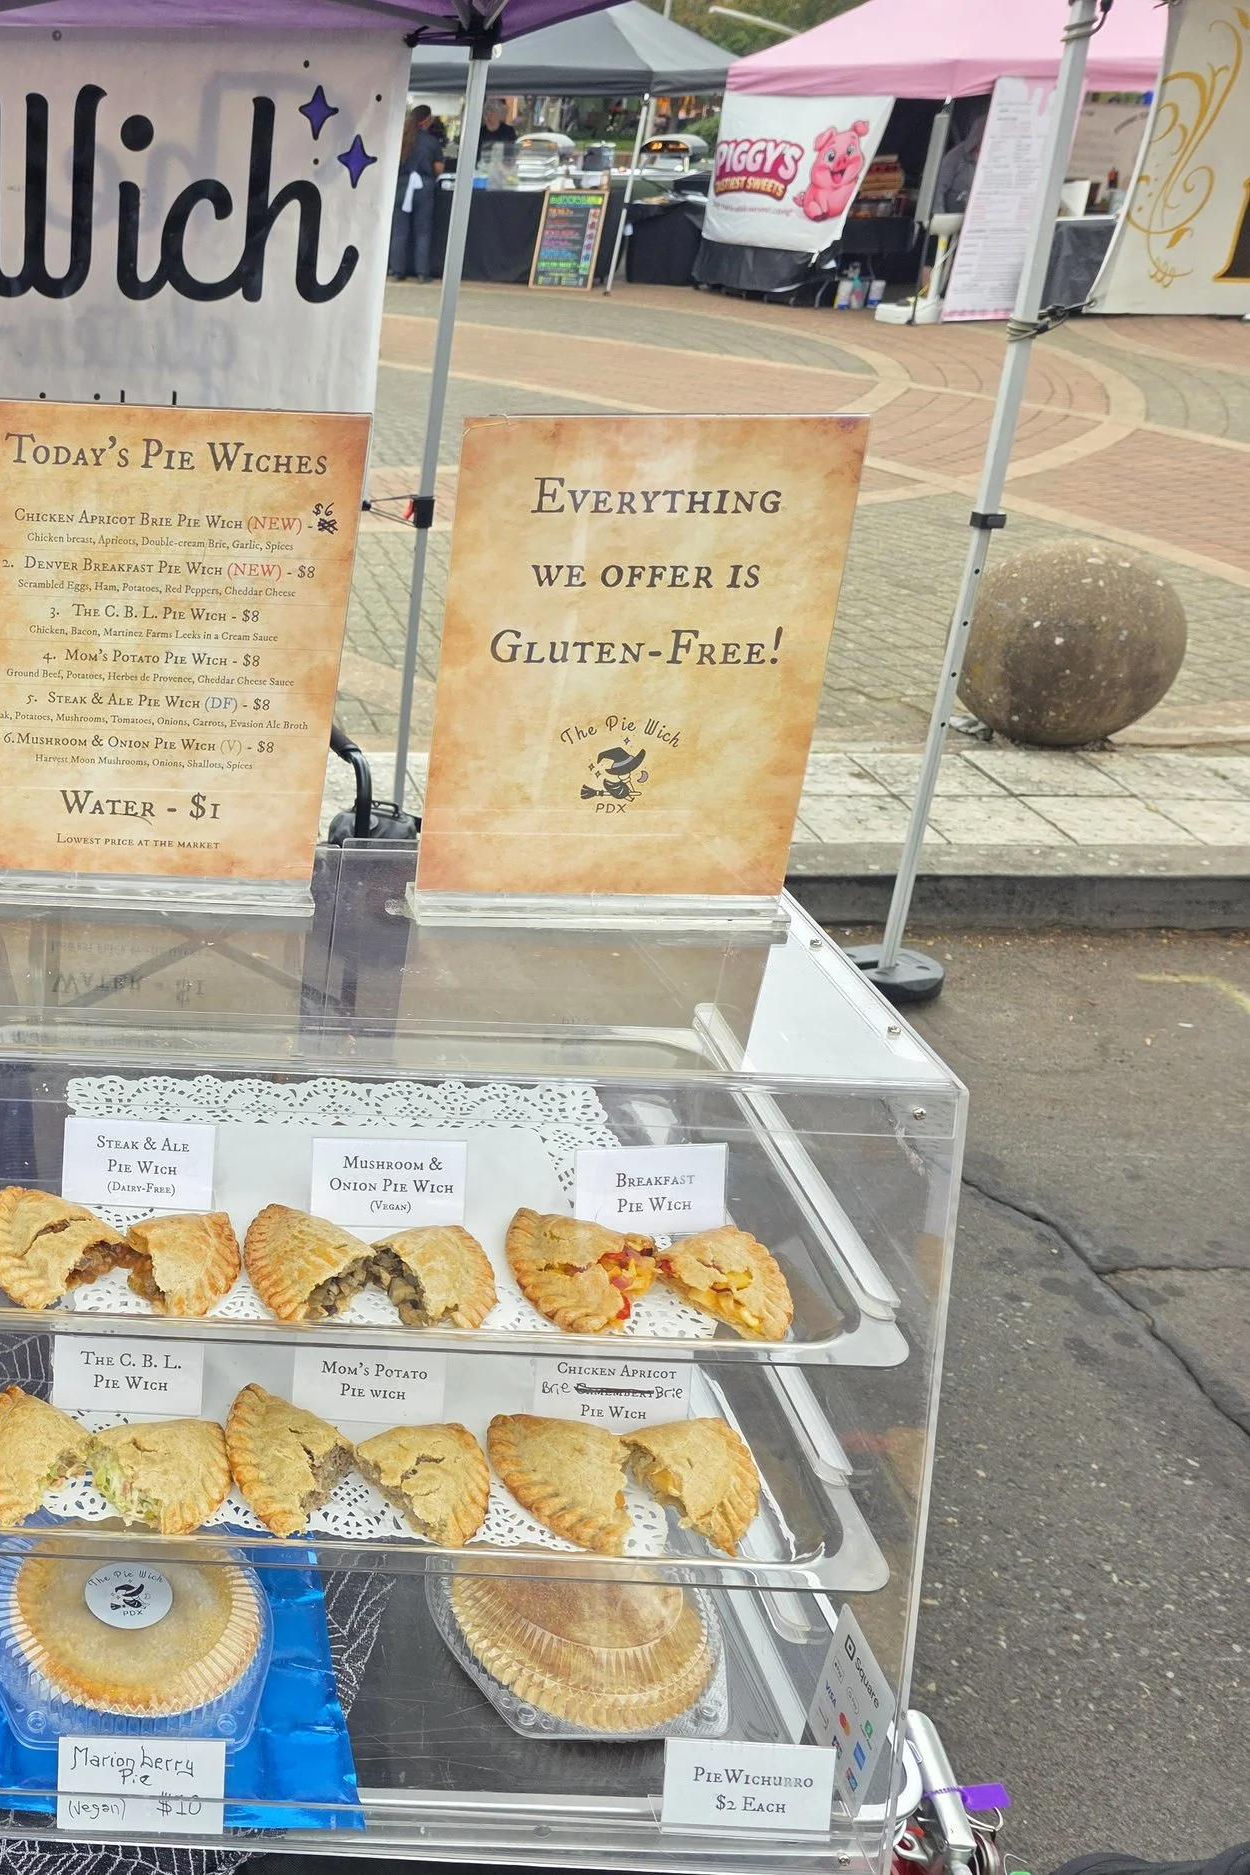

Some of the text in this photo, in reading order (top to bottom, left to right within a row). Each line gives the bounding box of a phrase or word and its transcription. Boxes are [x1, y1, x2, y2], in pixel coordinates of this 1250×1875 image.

[746, 176, 785, 197] SWEETS
[5, 432, 328, 476] TODAY'S PIE WICHES
[530, 476, 784, 515] EVERYTHING
[312, 502, 334, 517] $6
[14, 508, 75, 523] CHICKEN
[78, 510, 136, 525] APRICOT
[139, 512, 173, 527] BRIE
[176, 513, 201, 528] PIE
[205, 515, 243, 529] WICH
[247, 515, 303, 535] (NEW)
[27, 532, 294, 553] Chicken breast, Apricots, Double-cream Brie, Garlic, Spices
[24, 555, 78, 571] DENVER
[81, 557, 154, 573] BREAKFAST
[158, 560, 181, 574] PIE
[185, 561, 223, 575] WICH
[226, 562, 283, 582] (NEW)
[297, 564, 315, 579] $8
[531, 564, 760, 589] WE OFFER IS
[18, 579, 296, 597] Scrambled Eggs, Ham, Potatoes, Red Peppers, Cheddar Cheese
[72, 603, 100, 617] THE
[162, 606, 186, 620] PIE
[190, 608, 226, 621] WICH
[242, 609, 260, 623] $8
[490, 626, 784, 666] GLUTEN-FREE!
[64, 648, 108, 662] MOM'S
[112, 649, 160, 664] POTATO
[164, 651, 187, 664] PIE
[192, 653, 227, 666] WICH
[242, 653, 260, 667] $8
[48, 691, 87, 704] STEAK
[91, 692, 104, 705] &
[107, 693, 134, 706] ALE
[138, 694, 160, 707] PIE
[165, 695, 200, 709] WICH
[204, 696, 238, 714] (DF)
[253, 698, 270, 711] $8
[560, 715, 681, 748] The Pie Wich
[91, 734, 104, 747] &
[108, 736, 150, 749] ONION
[154, 737, 176, 750] PIE
[181, 738, 216, 751] WICH
[257, 740, 274, 753] $8
[35, 753, 253, 772] Harvest Moon Mushrooms, Onions, Shallots, Spices
[59, 790, 221, 826] WATER $1
[595, 803, 627, 814] PDX
[56, 833, 101, 845] LOWEST
[104, 838, 134, 846] PRICE
[177, 841, 220, 849] MARKET
[97, 1135, 190, 1152] STEAK & ALE
[107, 1159, 177, 1175] PIE WICH
[342, 1156, 443, 1171] MUSHROOM &
[107, 1181, 175, 1197] (DAIRY-FREE)
[330, 1177, 453, 1193] ONION PIE WICH
[615, 1173, 692, 1188] BREAKFAST
[370, 1200, 411, 1214] (VEGAN)
[617, 1196, 691, 1213] PIE WICH
[80, 1350, 115, 1366] THE
[321, 1360, 427, 1380] MOM'S POTATO
[557, 1362, 677, 1379] CHICKEN APRICOT
[93, 1374, 168, 1391] PIE WICH
[340, 1383, 365, 1397] PIE
[541, 1380, 571, 1395] Brie
[654, 1385, 684, 1400] Brie
[580, 1404, 646, 1419] PIE WICH
[87, 1570, 163, 1586] The Pie Wich
[854, 1657, 880, 1709] Square
[824, 1680, 838, 1709] VISA
[118, 1768, 153, 1786] Pie
[156, 1790, 202, 1817] $10
[716, 1794, 786, 1813] $2 EACH
